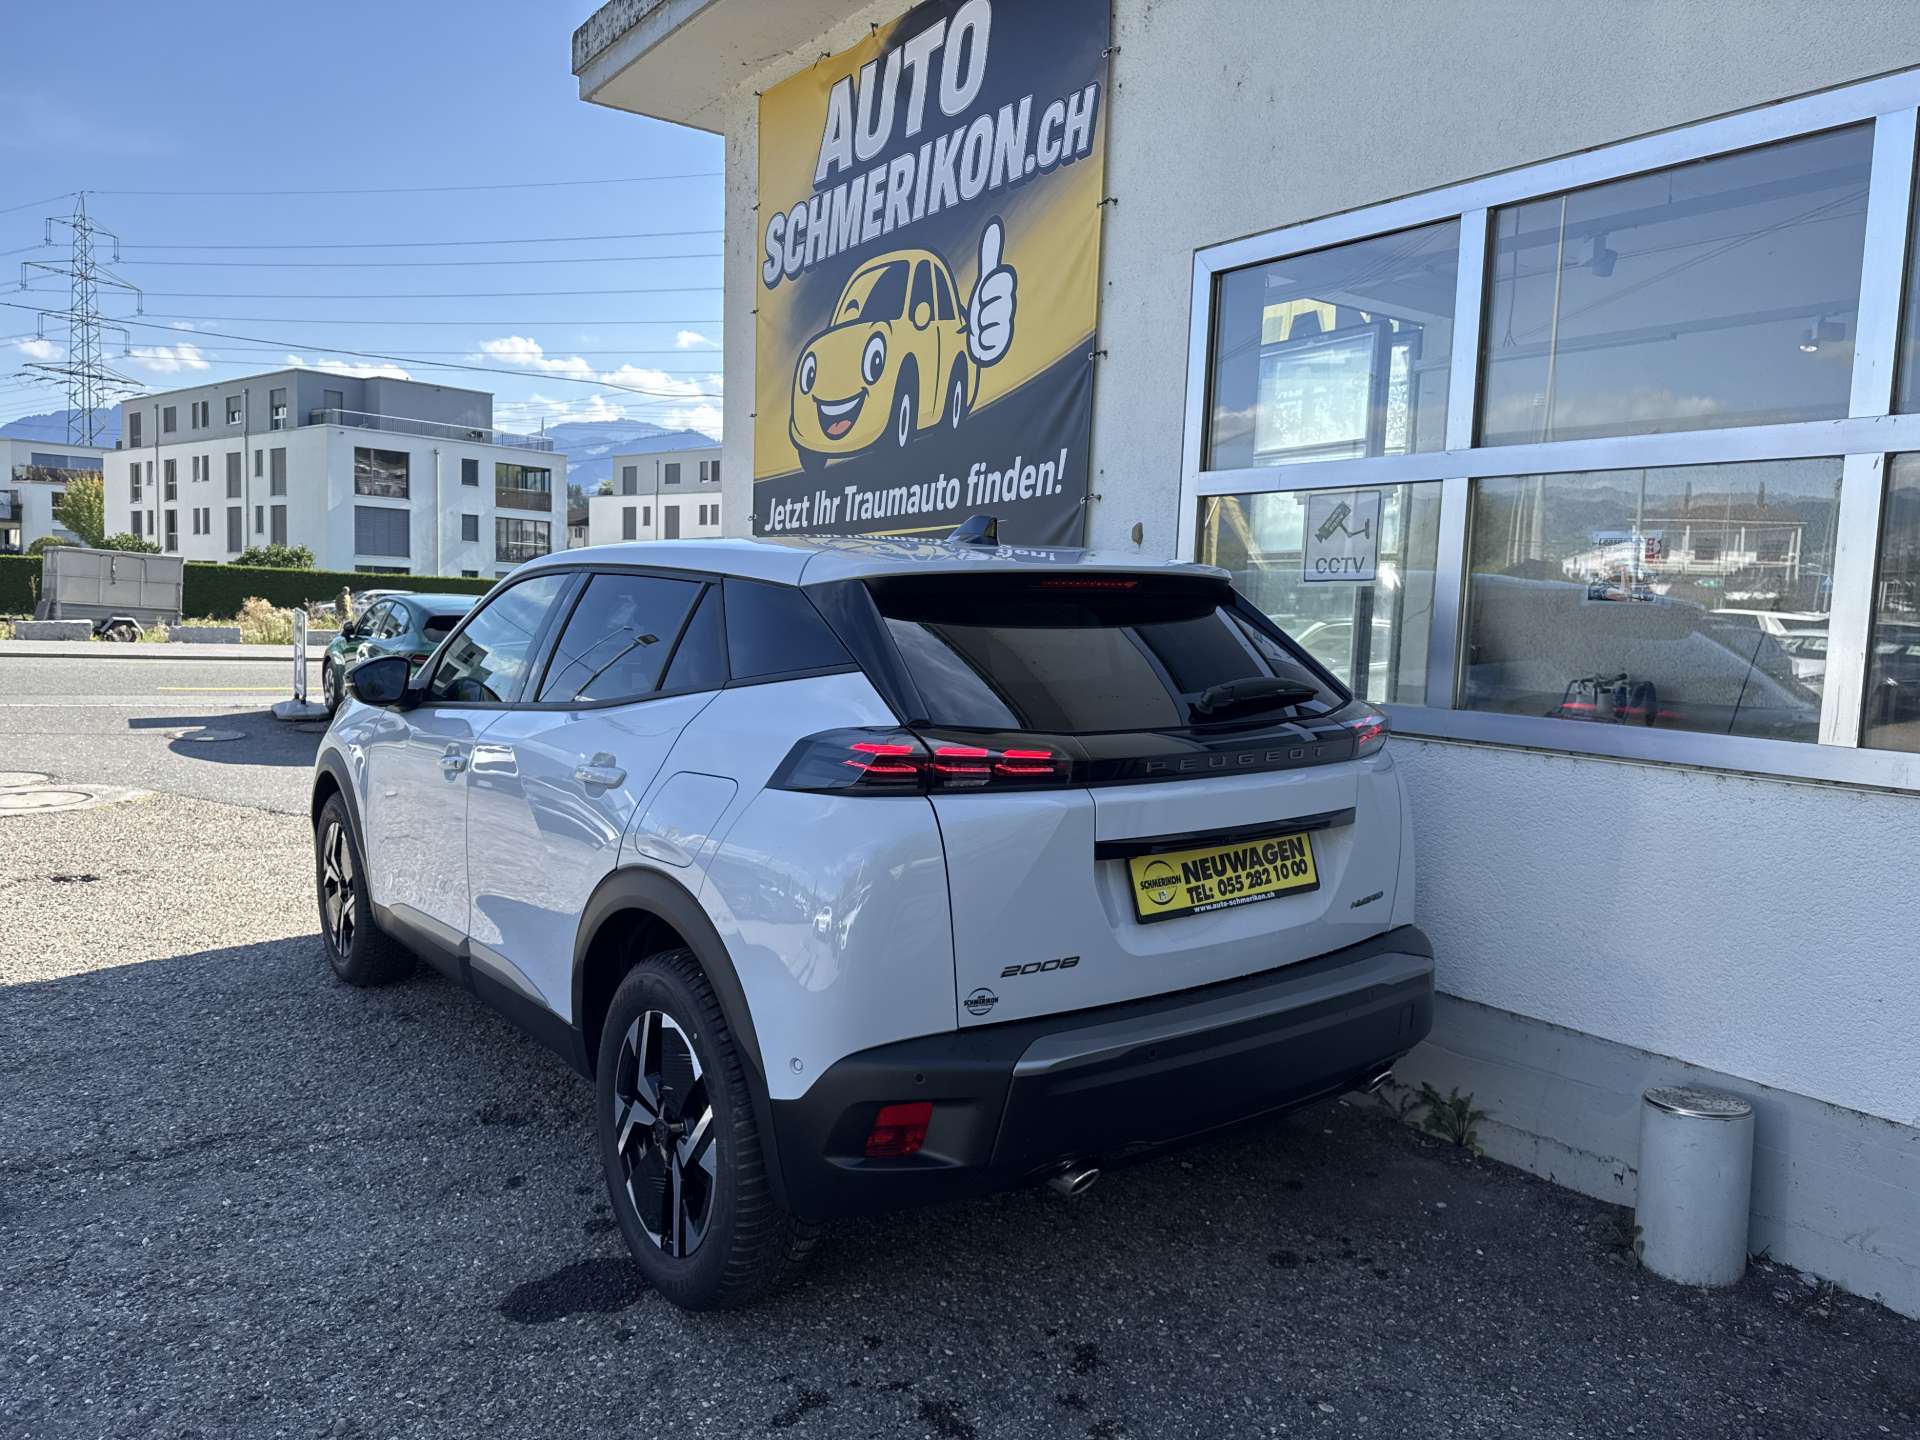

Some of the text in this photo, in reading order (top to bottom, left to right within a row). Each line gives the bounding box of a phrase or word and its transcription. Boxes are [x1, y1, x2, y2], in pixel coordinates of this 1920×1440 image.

[813, 0, 992, 184] AUTO
[763, 83, 1098, 286] SCHMERIKON.CH
[764, 448, 1067, 531] Jetzt Ihr Traumauto finden!
[1315, 556, 1365, 574] CCTV
[1146, 746, 1324, 773] PEUGEOT
[1181, 837, 1306, 884] NEUWAGEN
[1186, 859, 1308, 904] TEL: 055 282 10 00
[1001, 956, 1080, 978] 2008
